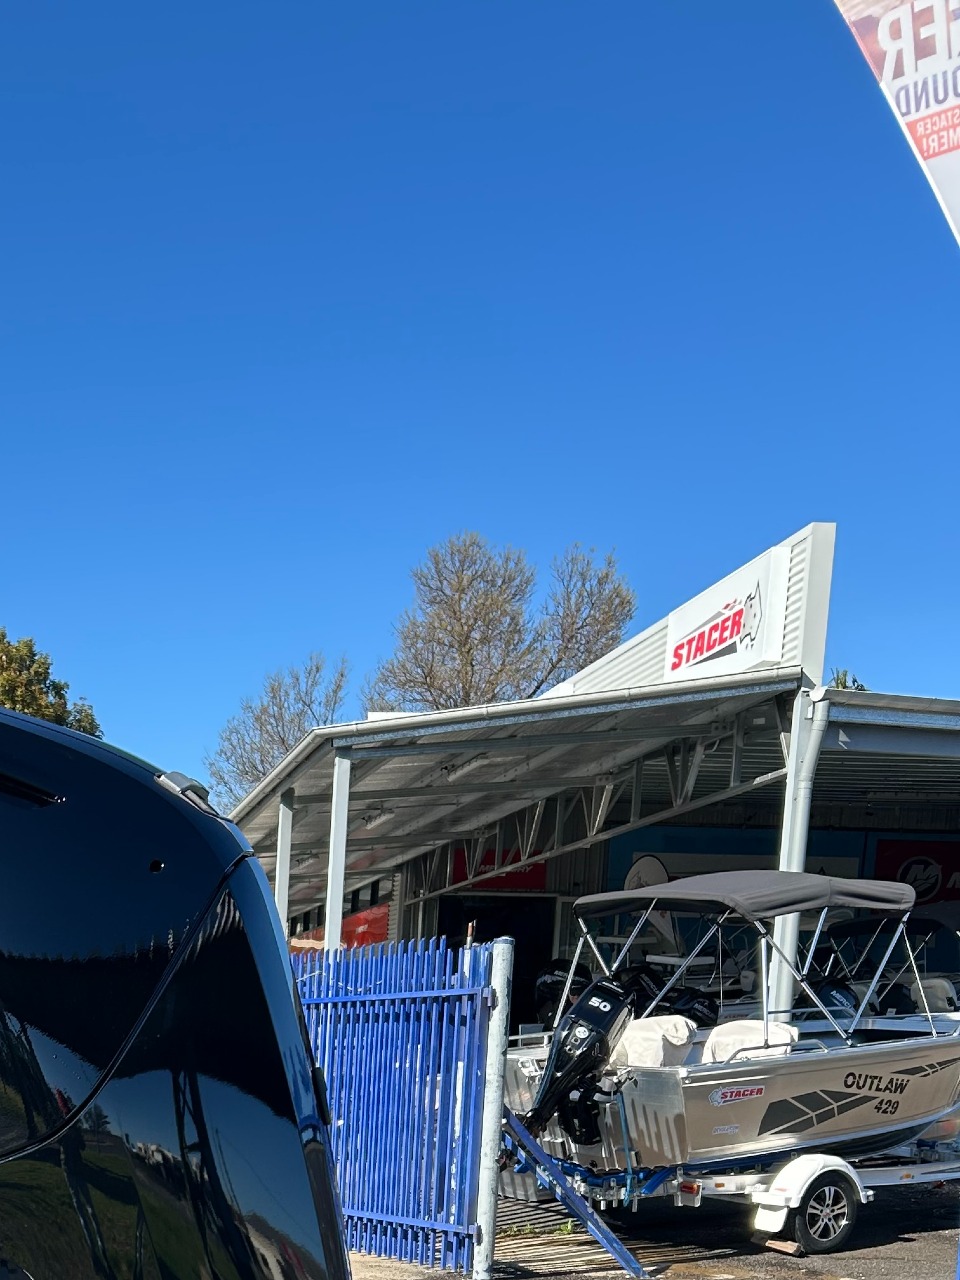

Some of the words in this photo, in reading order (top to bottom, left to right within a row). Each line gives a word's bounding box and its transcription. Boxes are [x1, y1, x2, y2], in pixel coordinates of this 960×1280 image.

[671, 607, 744, 671] STACER
[588, 996, 611, 1012] 50
[843, 1072, 911, 1096] OUTLAW
[721, 1086, 764, 1100] STACER
[874, 1099, 900, 1116] 429
